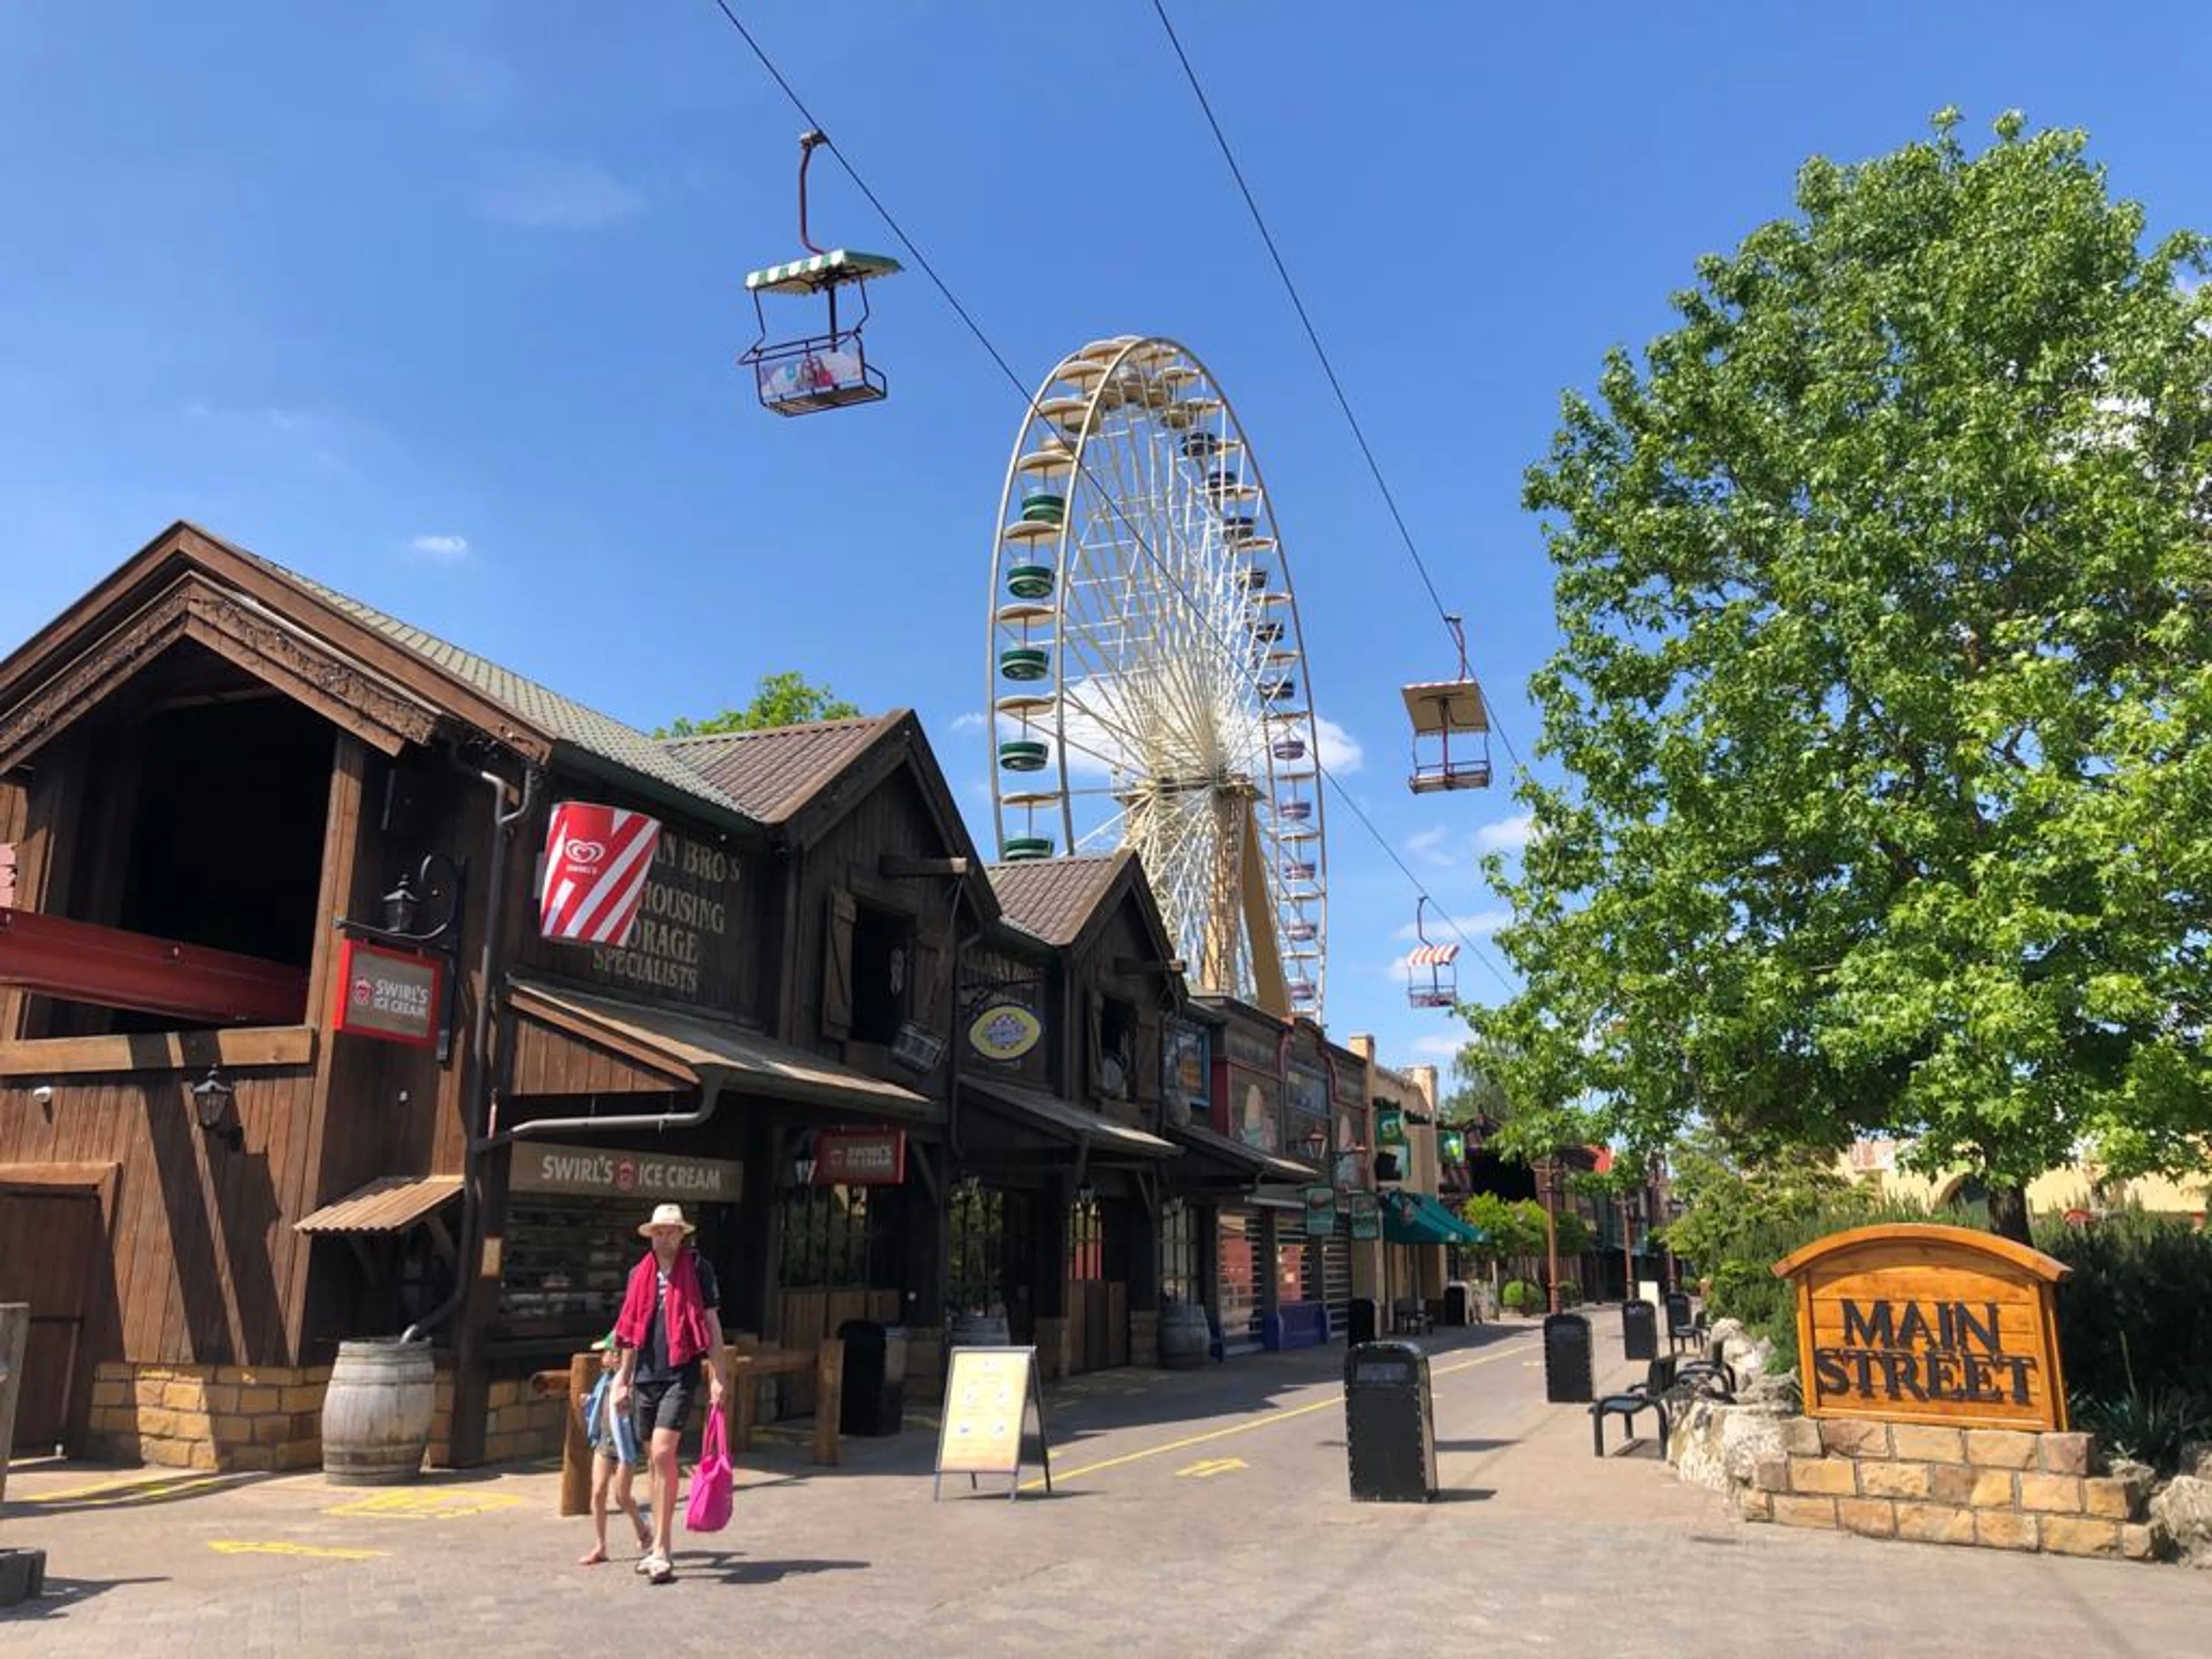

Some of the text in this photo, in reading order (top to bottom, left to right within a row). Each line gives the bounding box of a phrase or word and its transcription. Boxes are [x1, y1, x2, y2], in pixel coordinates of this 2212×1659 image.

[638, 881, 726, 934] HOUSING
[627, 918, 699, 965] ORAGE
[375, 979, 429, 1004] SWIRL'S
[541, 1154, 721, 1190] SWIRL'S ICE CREAM
[1840, 1298, 2003, 1355] MAIN
[1815, 1347, 2039, 1406] STREET
